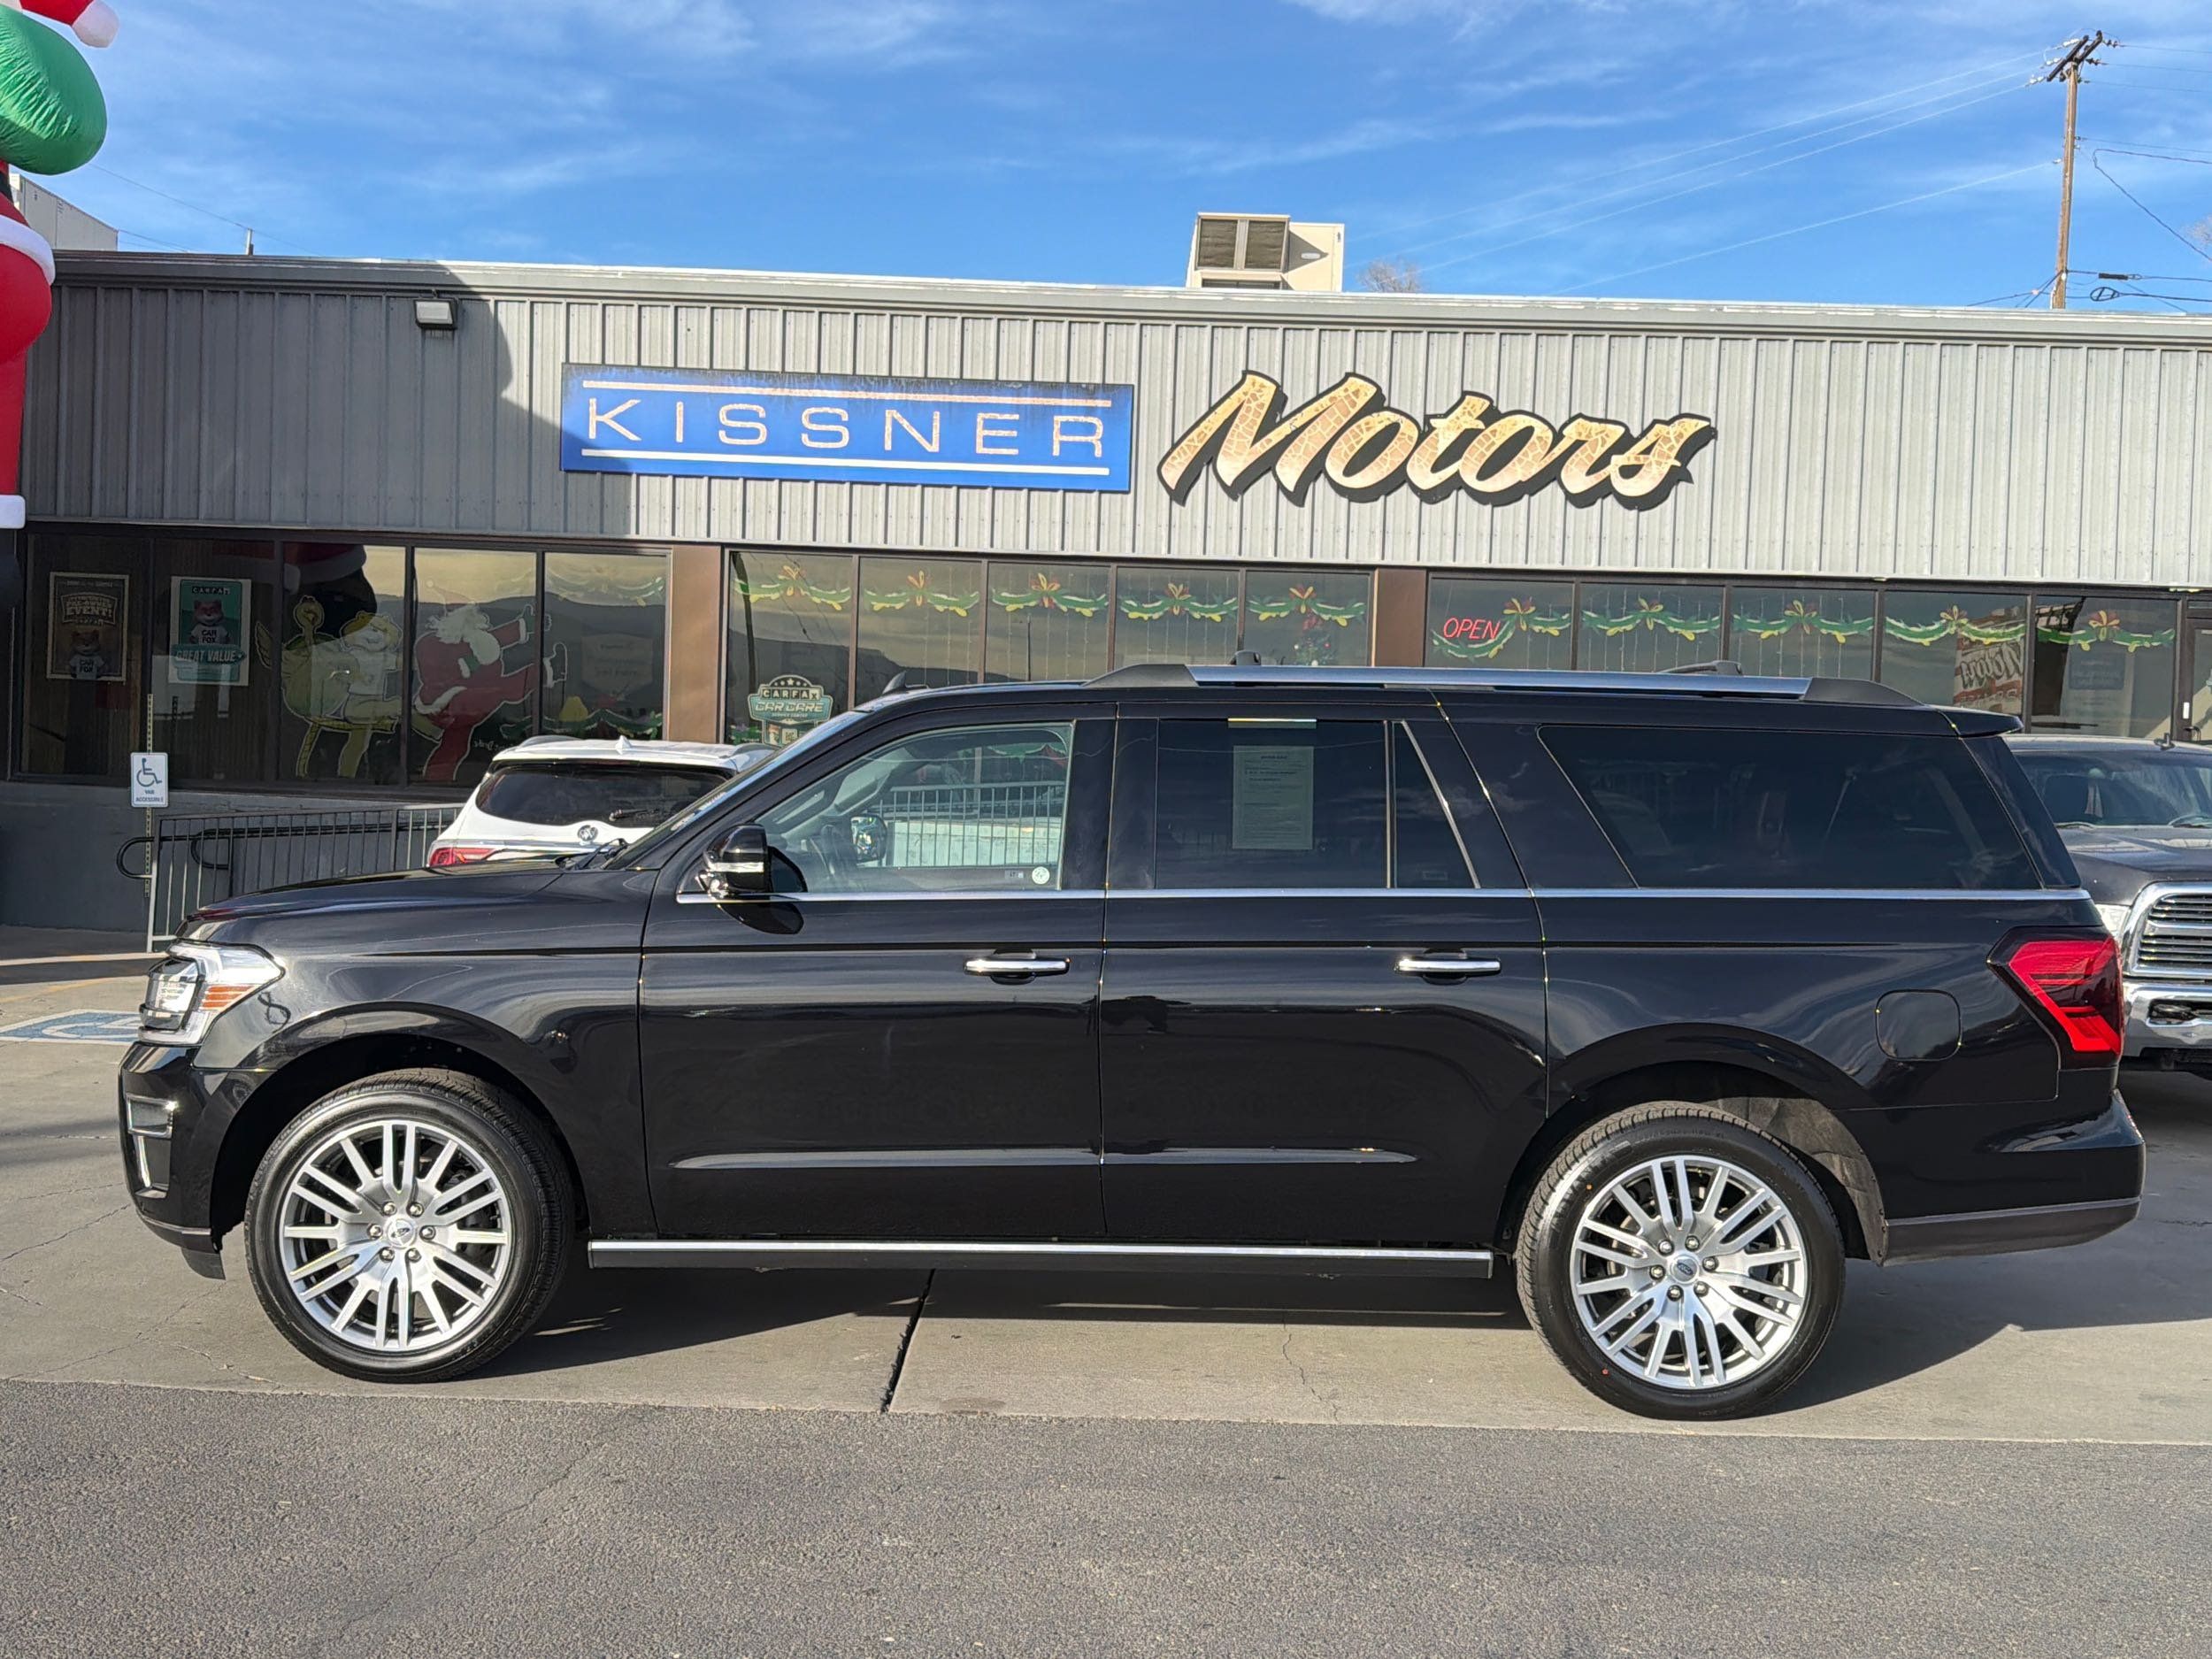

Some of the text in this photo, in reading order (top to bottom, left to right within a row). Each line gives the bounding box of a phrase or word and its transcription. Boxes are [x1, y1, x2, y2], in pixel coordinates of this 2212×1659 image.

[587, 396, 1104, 457] KISSNER
[1158, 369, 1717, 510] Motors
[1443, 617, 1502, 640] OPEN
[177, 649, 236, 662] GREAT VALUE
[763, 689, 820, 700] CARFAX
[755, 702, 824, 712] CAR CARE
